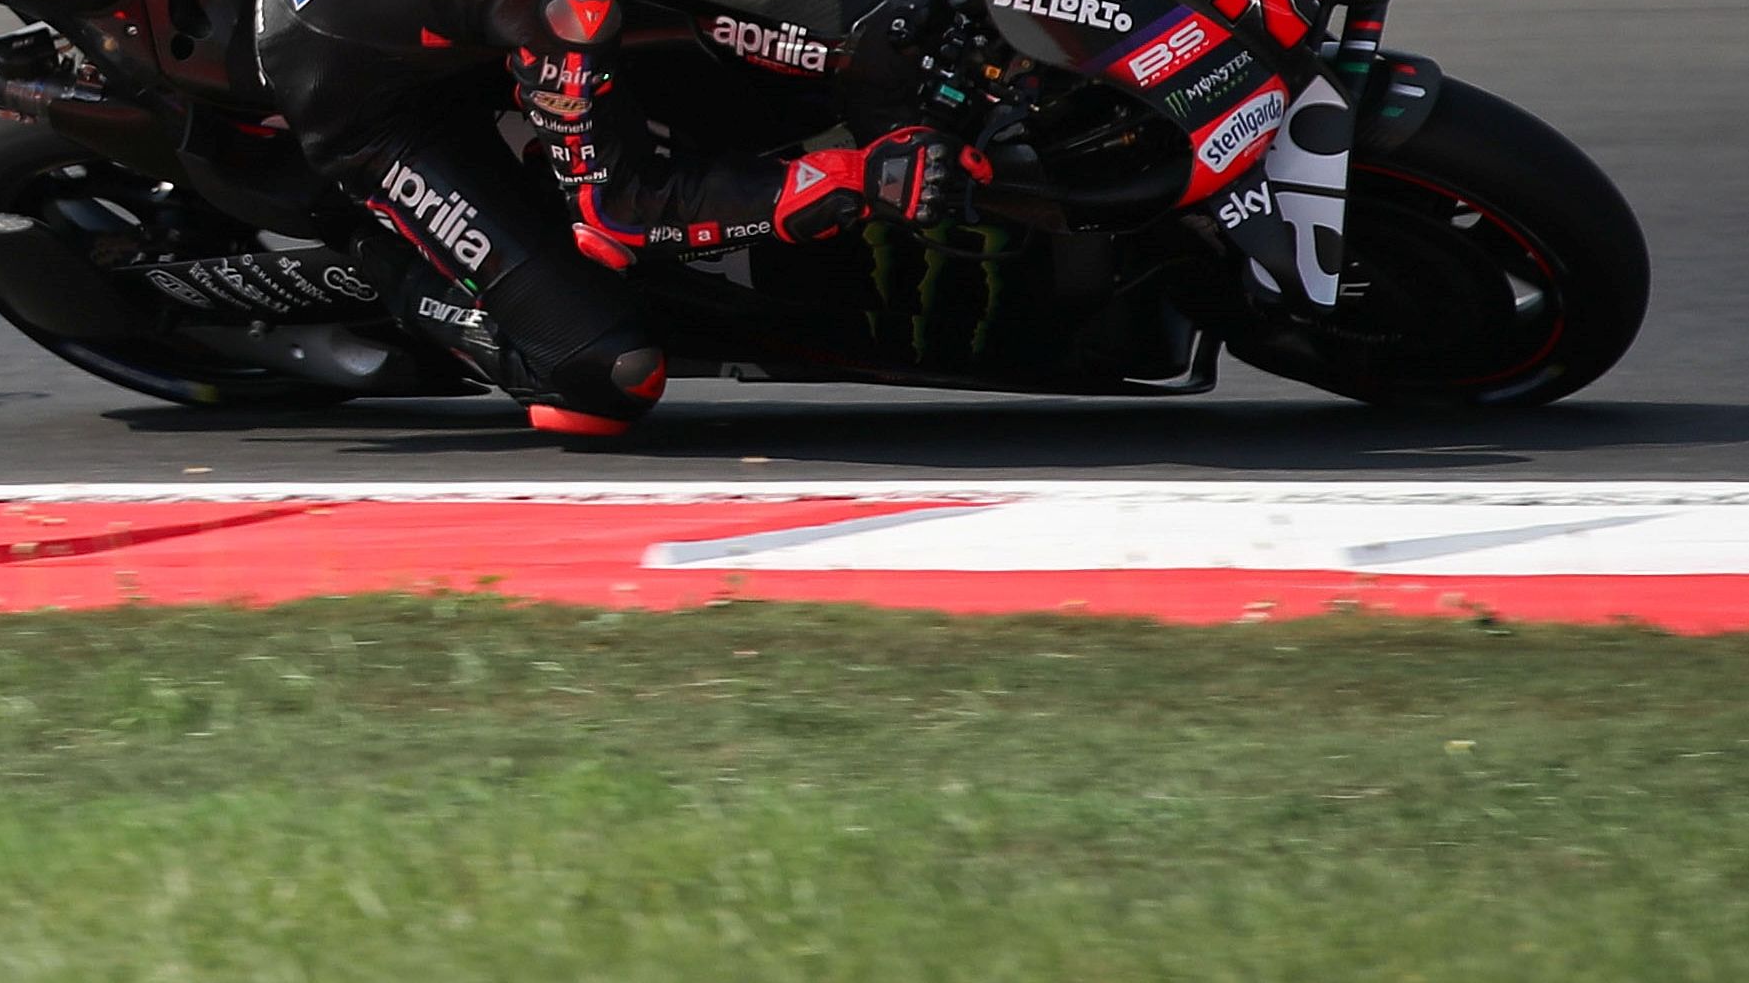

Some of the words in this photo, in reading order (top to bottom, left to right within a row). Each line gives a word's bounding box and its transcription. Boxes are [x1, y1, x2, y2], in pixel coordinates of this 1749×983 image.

[713, 15, 828, 72] aprilia
[1129, 21, 1205, 81] BS
[1186, 50, 1253, 100] MONSTER
[1206, 93, 1283, 164] sterilgarda
[1219, 181, 1272, 229] sky
